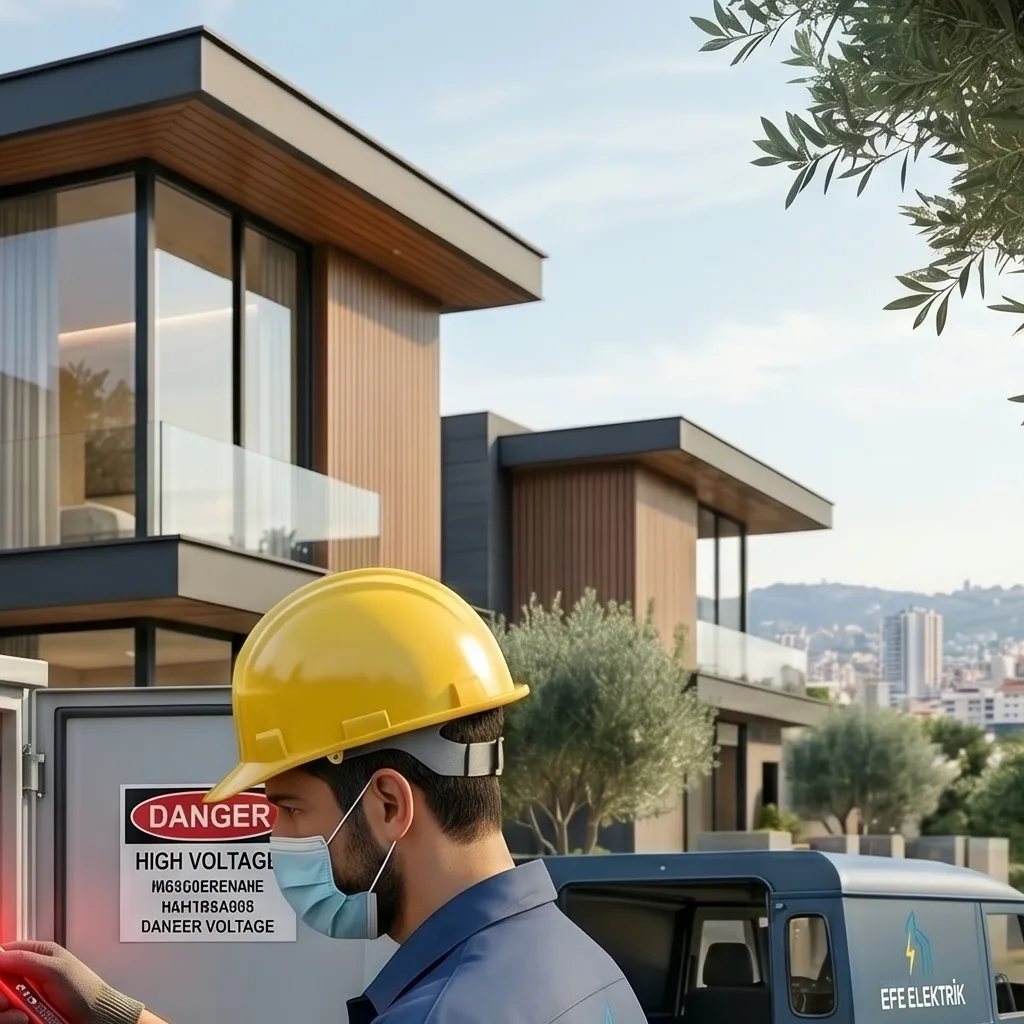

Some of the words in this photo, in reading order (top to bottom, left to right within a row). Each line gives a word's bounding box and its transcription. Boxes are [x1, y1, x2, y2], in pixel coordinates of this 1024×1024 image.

[149, 803, 271, 828] DANGER
[135, 851, 183, 871] HIGH
[205, 919, 275, 933] VOLTAGE
[880, 987, 907, 1010] EFE
[907, 978, 966, 1008] ELEKTRİK
